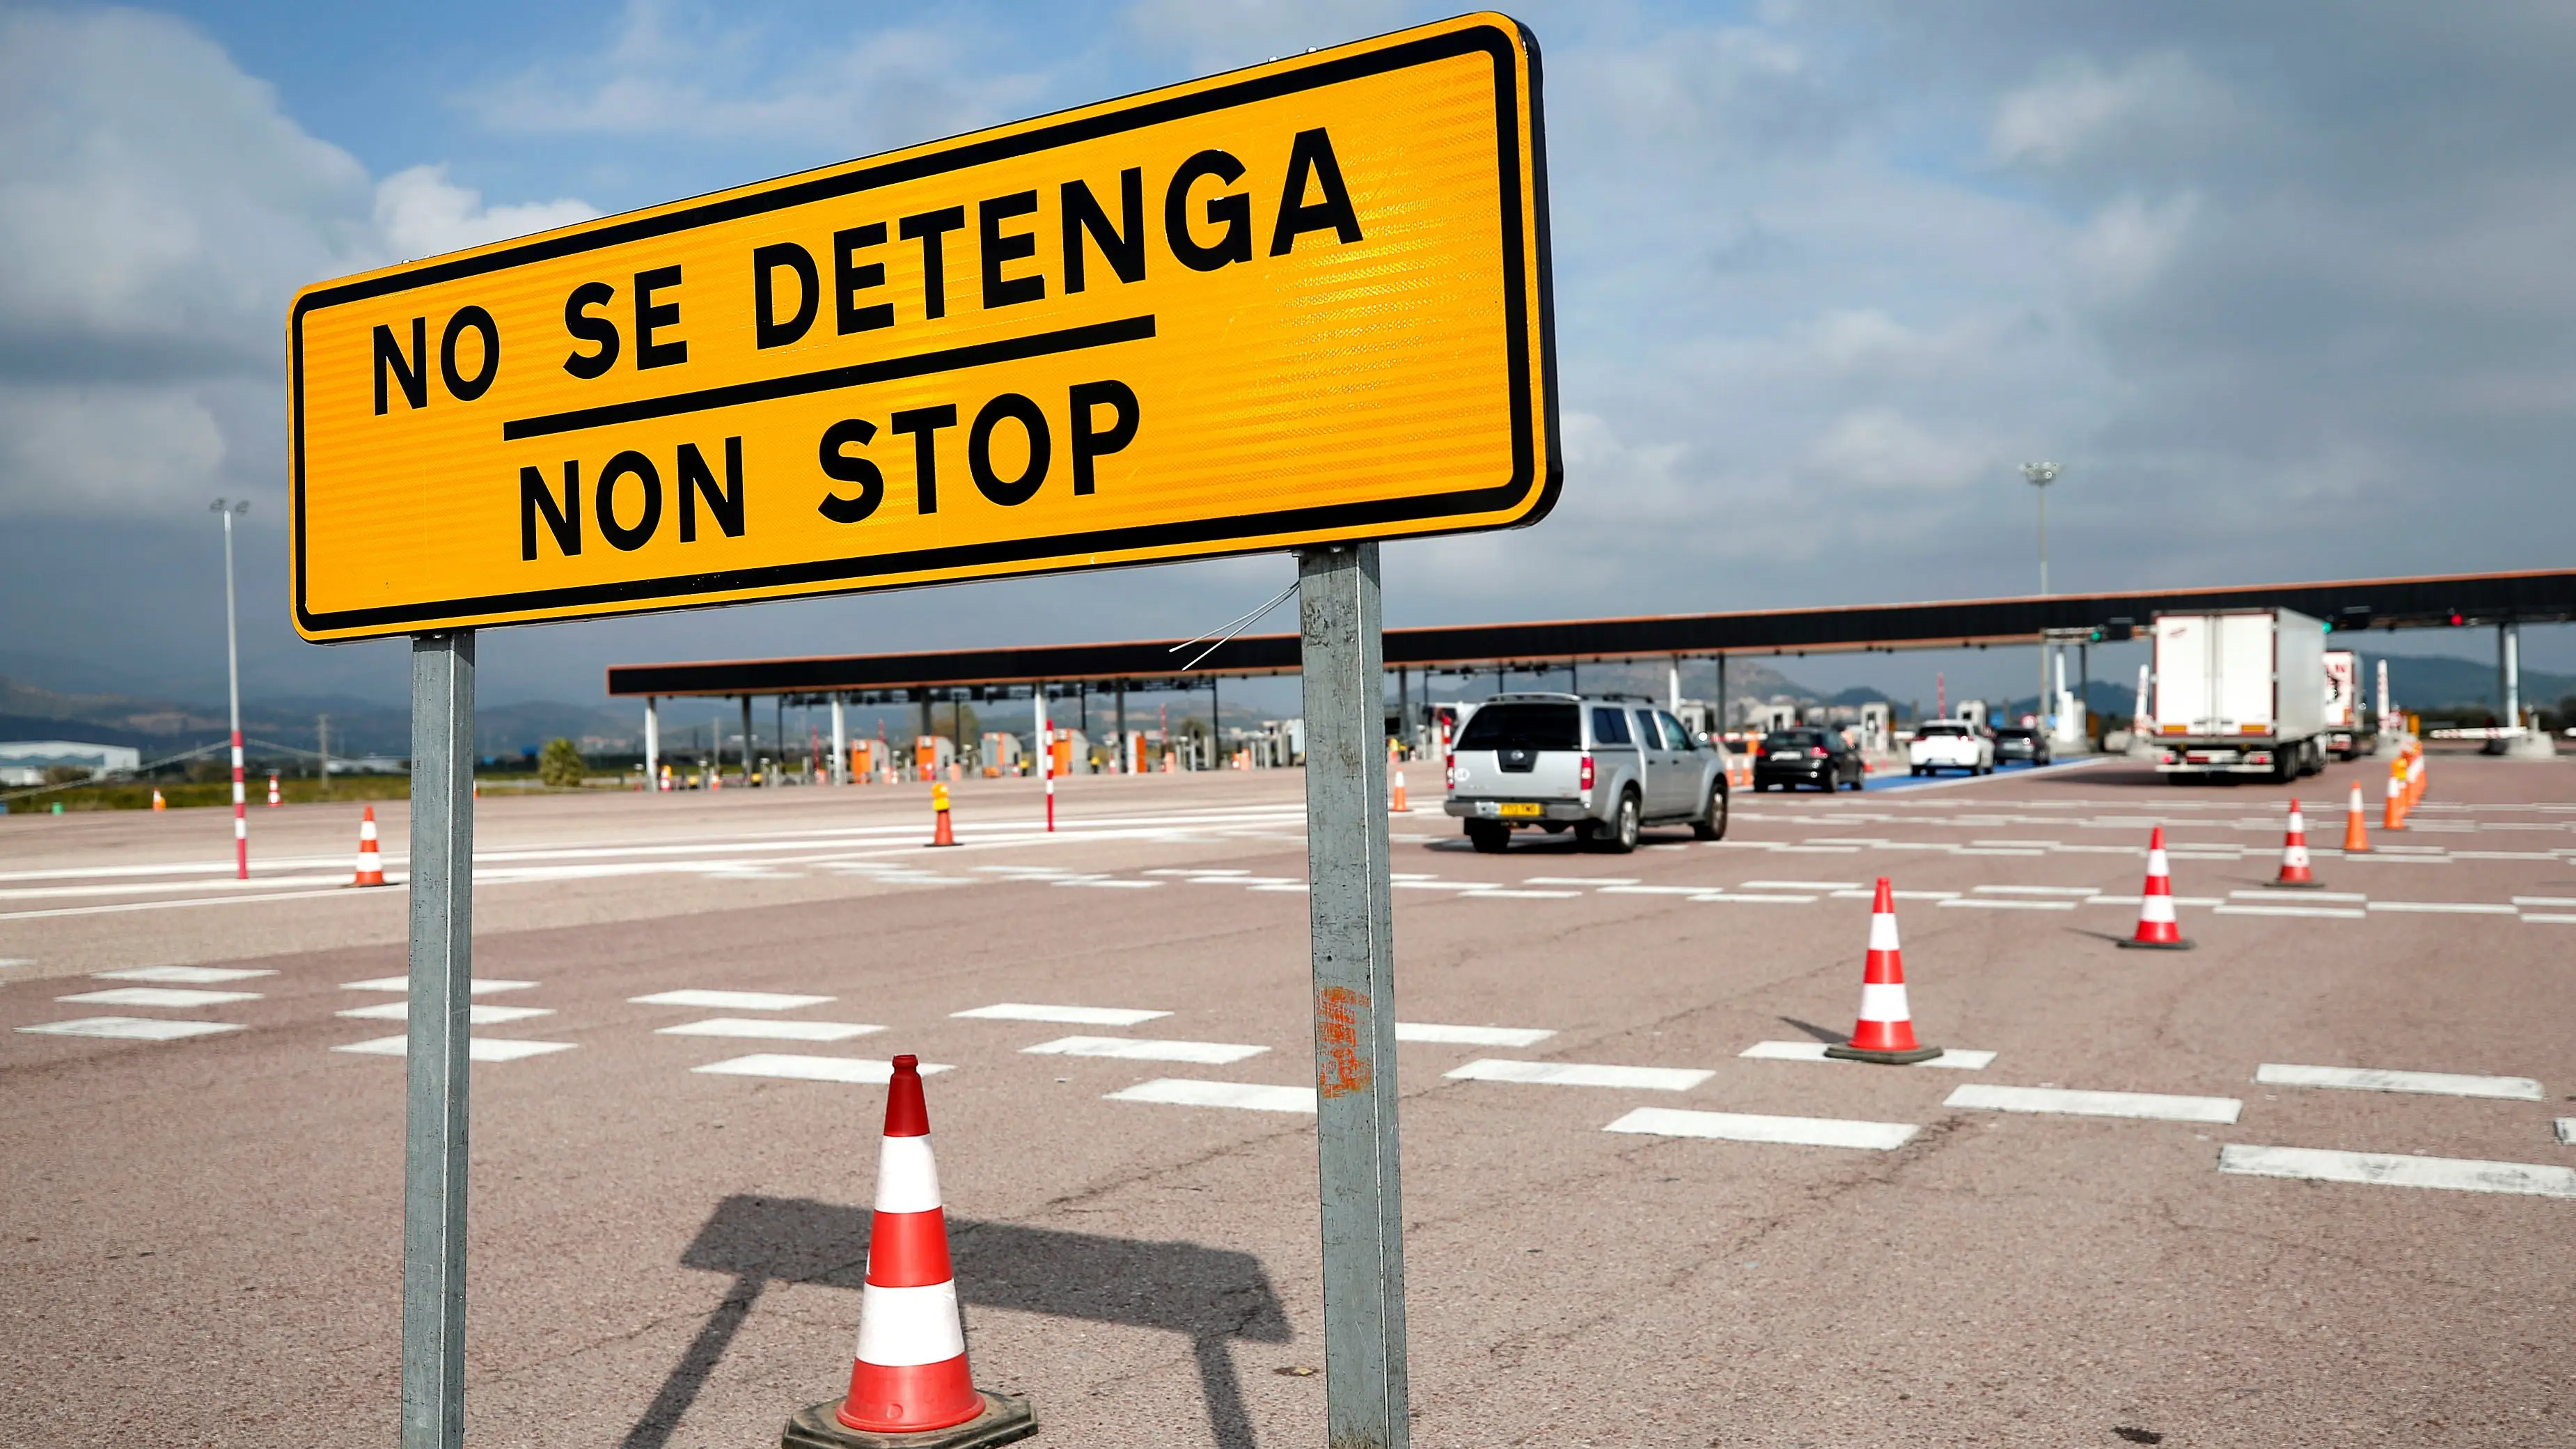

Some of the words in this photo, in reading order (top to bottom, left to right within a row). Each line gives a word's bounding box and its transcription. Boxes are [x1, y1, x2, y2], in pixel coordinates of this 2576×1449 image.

[372, 305, 500, 416] NO
[563, 264, 688, 379] SE
[753, 127, 1364, 350] DETENGA
[519, 435, 745, 561] NON
[817, 379, 1140, 524] STOP
